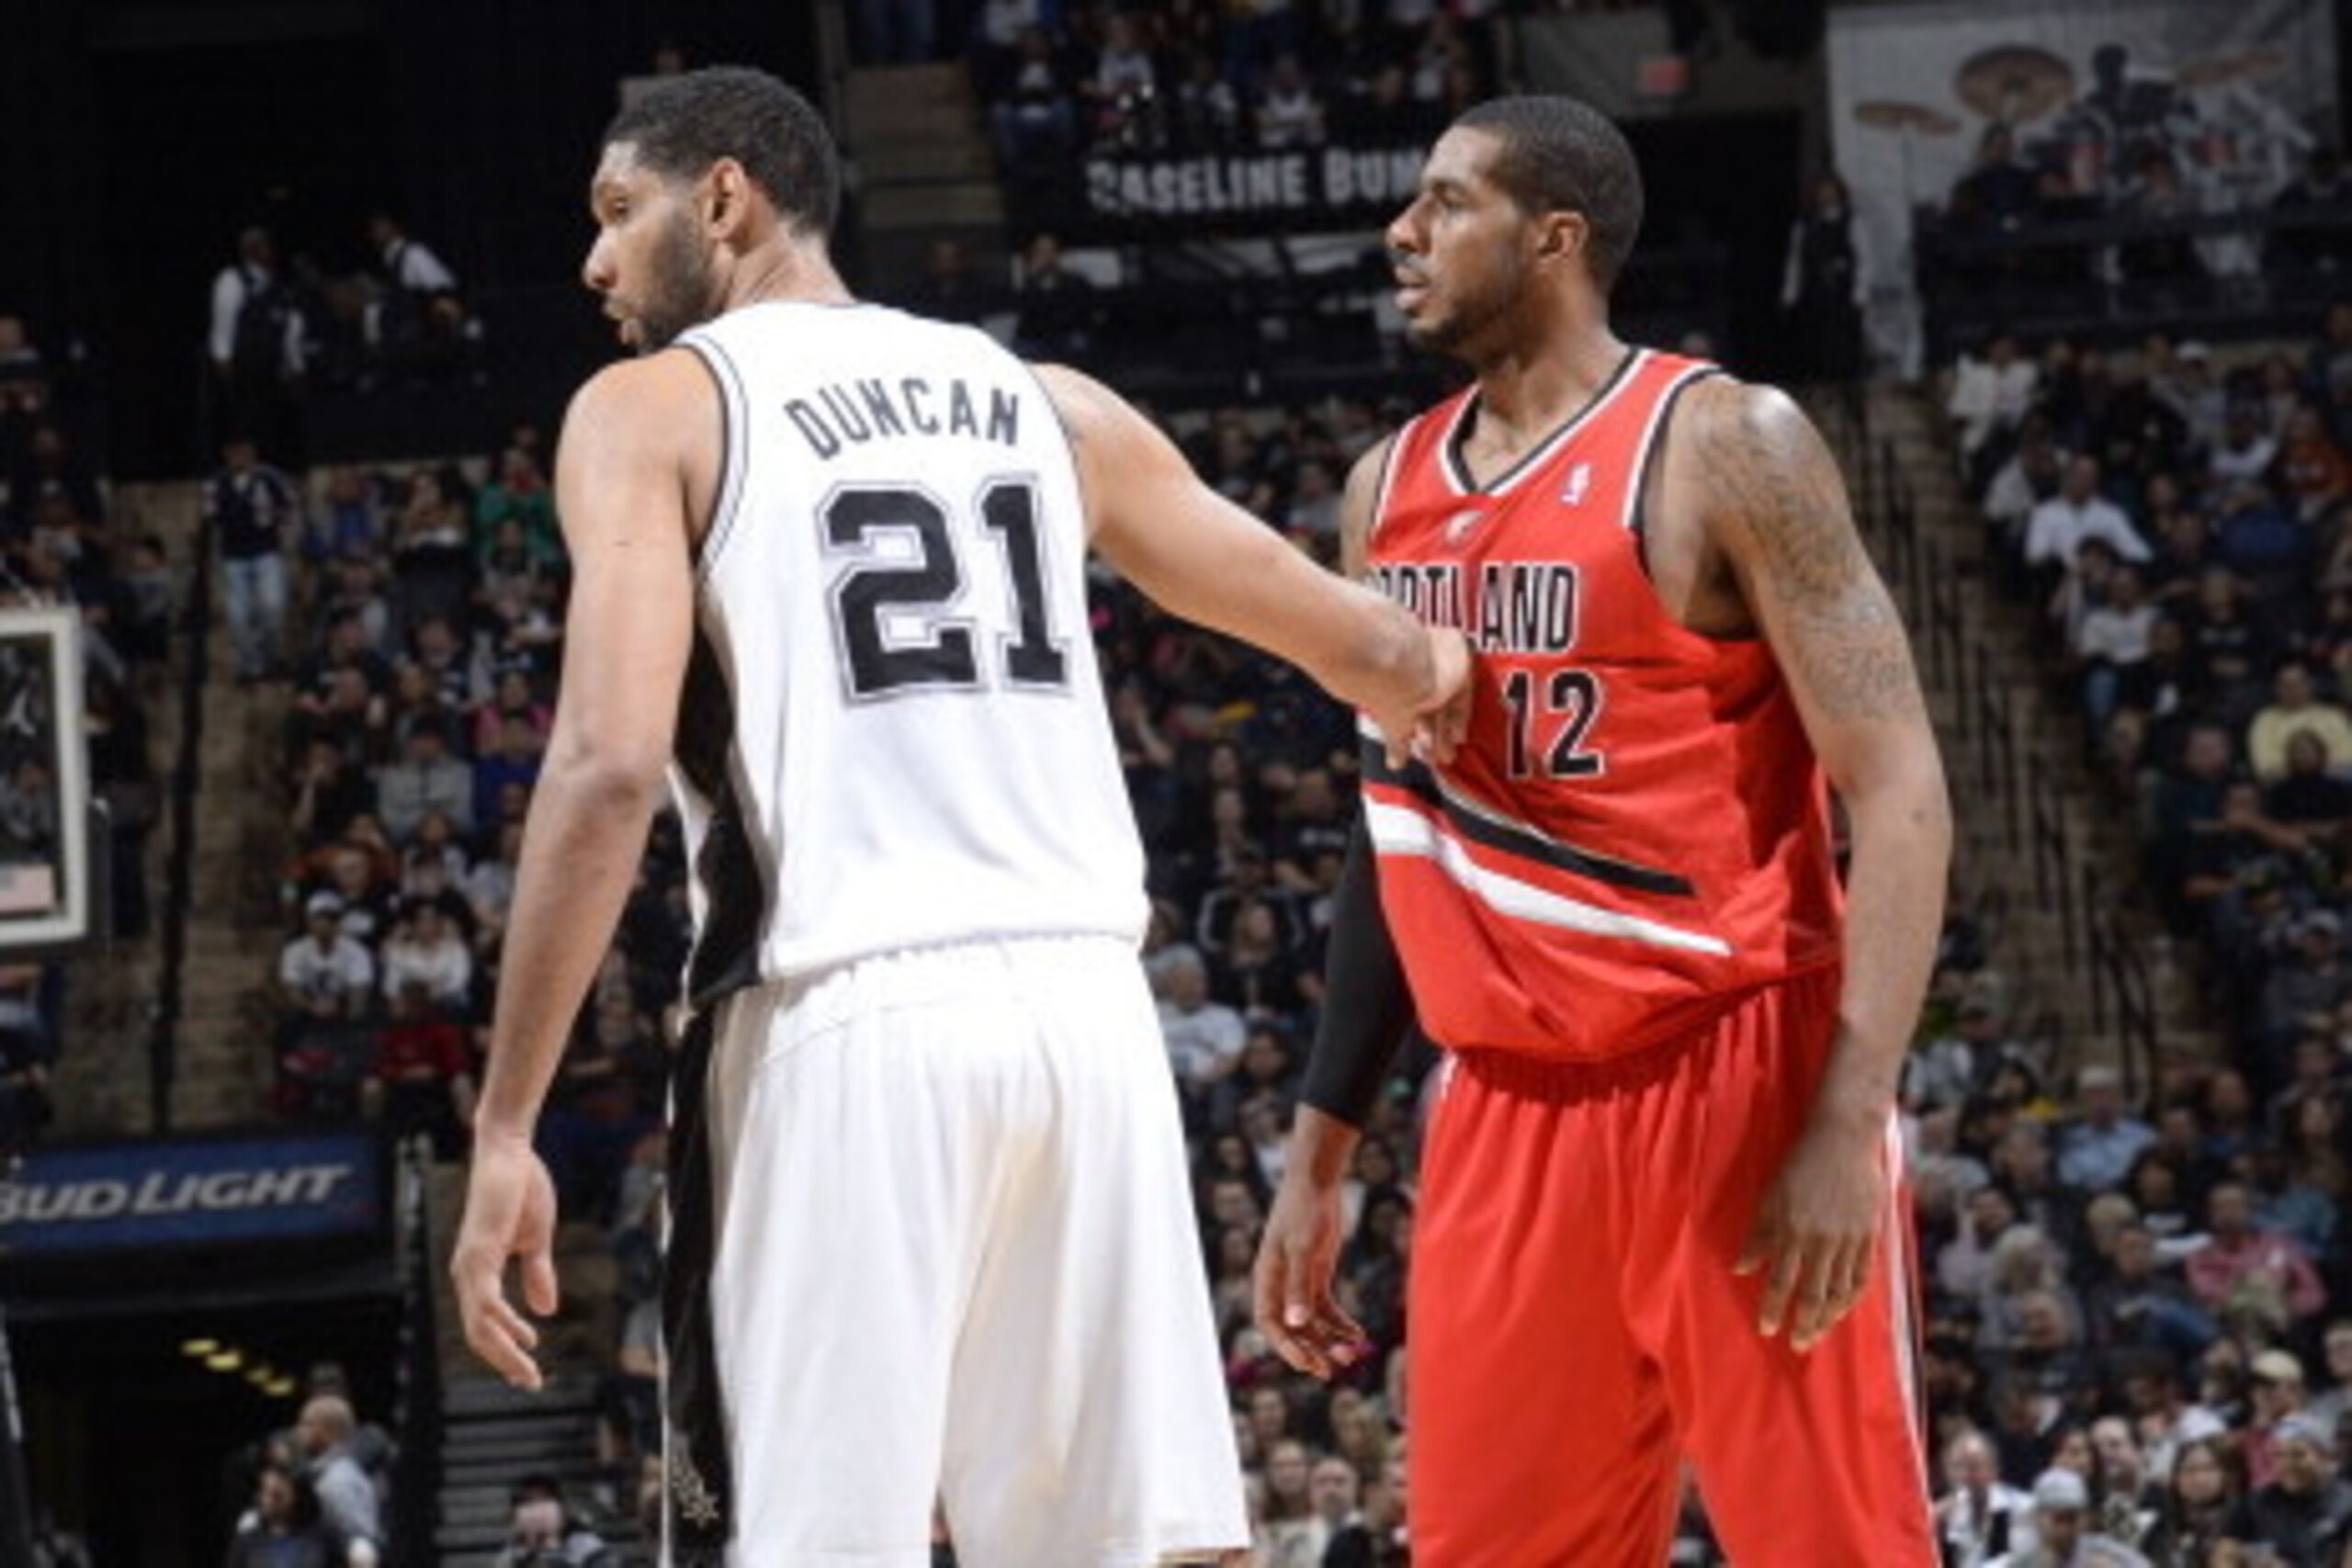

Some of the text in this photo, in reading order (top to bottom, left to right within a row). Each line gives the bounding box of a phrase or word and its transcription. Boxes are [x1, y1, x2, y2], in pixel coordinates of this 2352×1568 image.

[783, 378, 1019, 460] DUNCAN
[815, 471, 1072, 707] 21
[1501, 669, 1604, 779] 12
[133, 1164, 352, 1214] LIGHT
